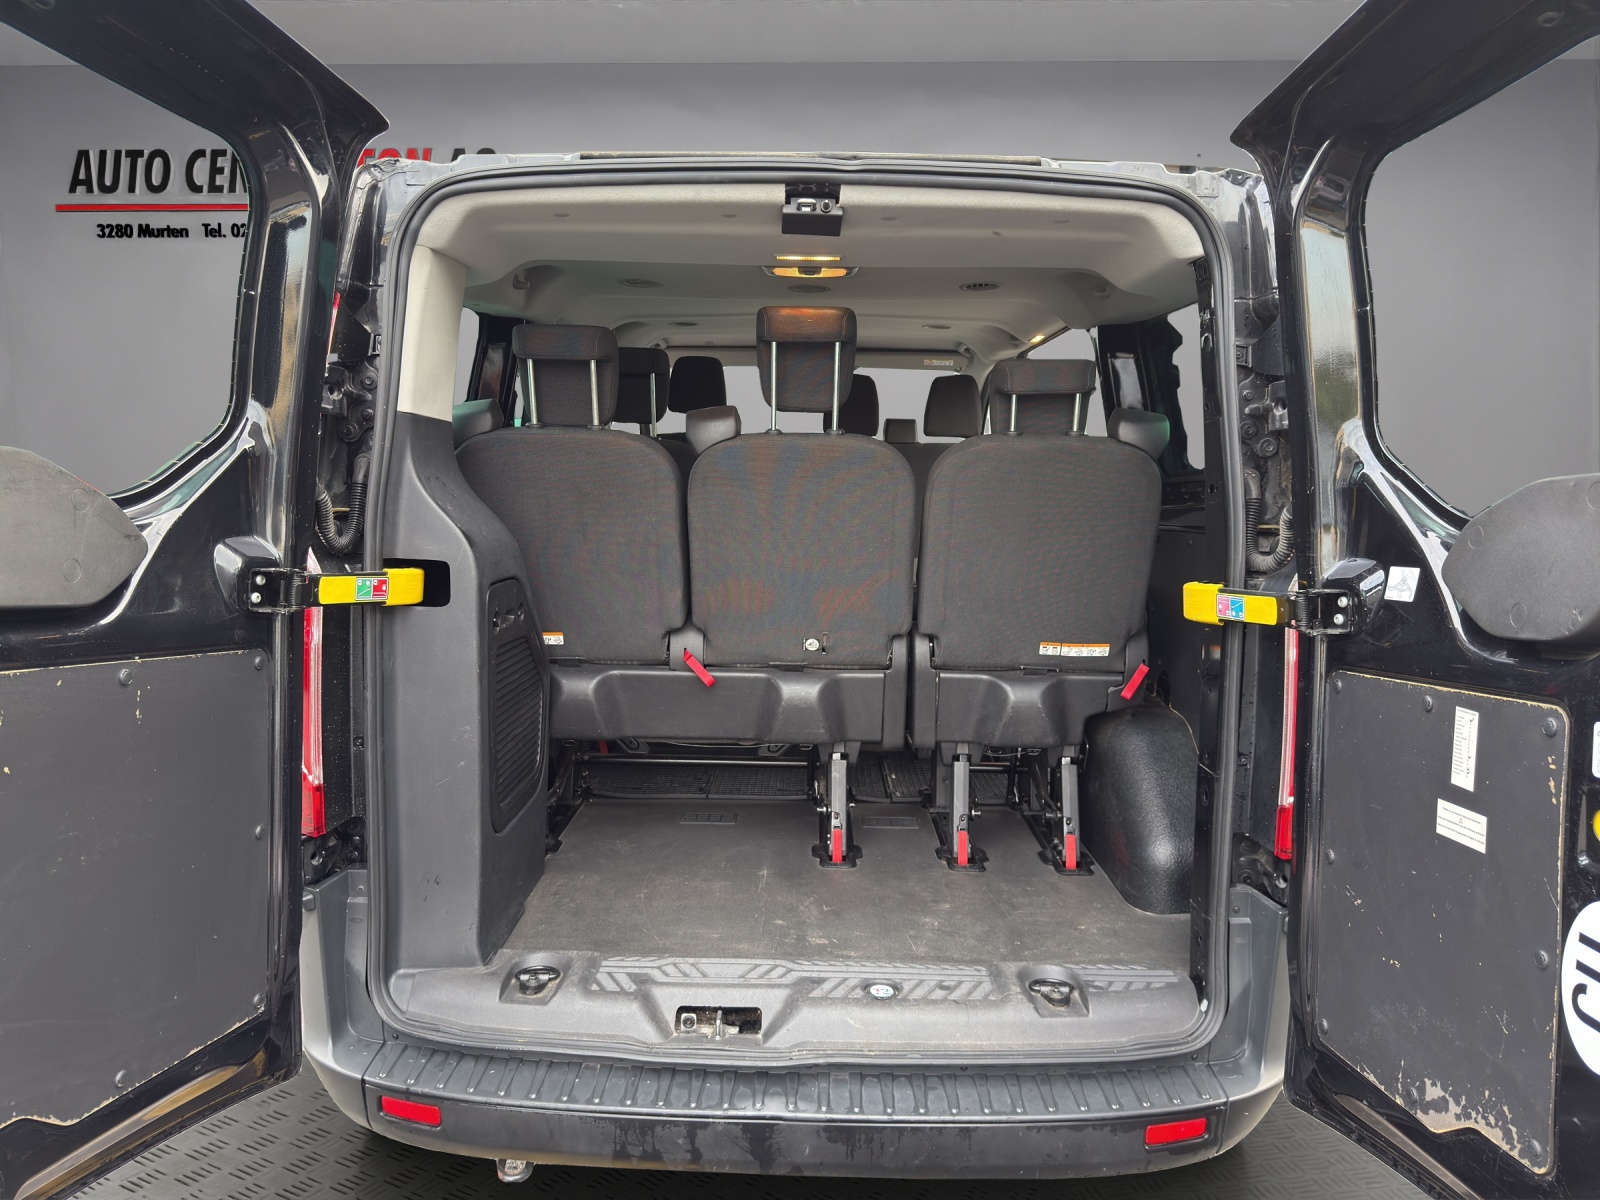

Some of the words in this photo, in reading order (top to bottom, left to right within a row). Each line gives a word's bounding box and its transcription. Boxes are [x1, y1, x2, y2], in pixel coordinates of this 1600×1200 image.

[69, 149, 170, 194] AUTO
[96, 223, 134, 239] 3280
[137, 223, 190, 239] Murten
[201, 222, 227, 239] Tel.
